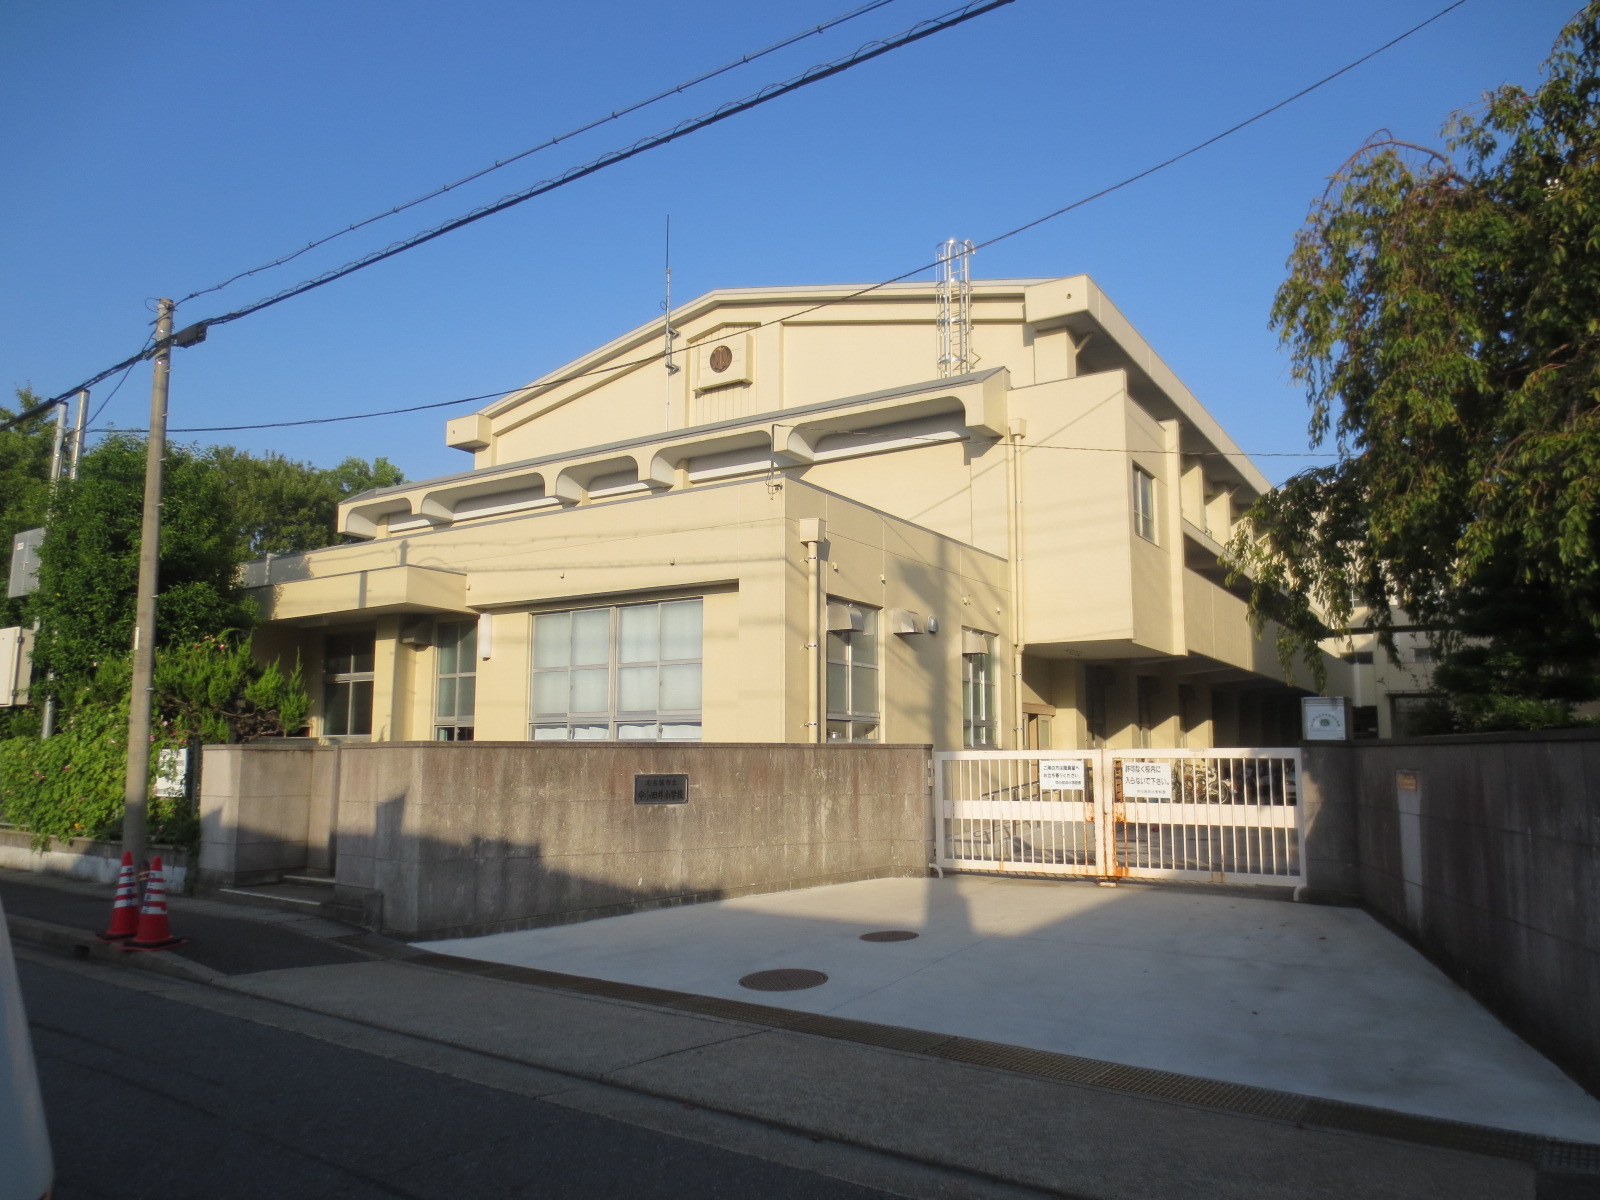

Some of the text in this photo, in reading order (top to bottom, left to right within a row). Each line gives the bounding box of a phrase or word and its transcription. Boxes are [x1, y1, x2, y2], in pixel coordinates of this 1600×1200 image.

[1125, 765, 1161, 773] 許可なく校内に
[1125, 776, 1169, 786] 入らないで下さい。
